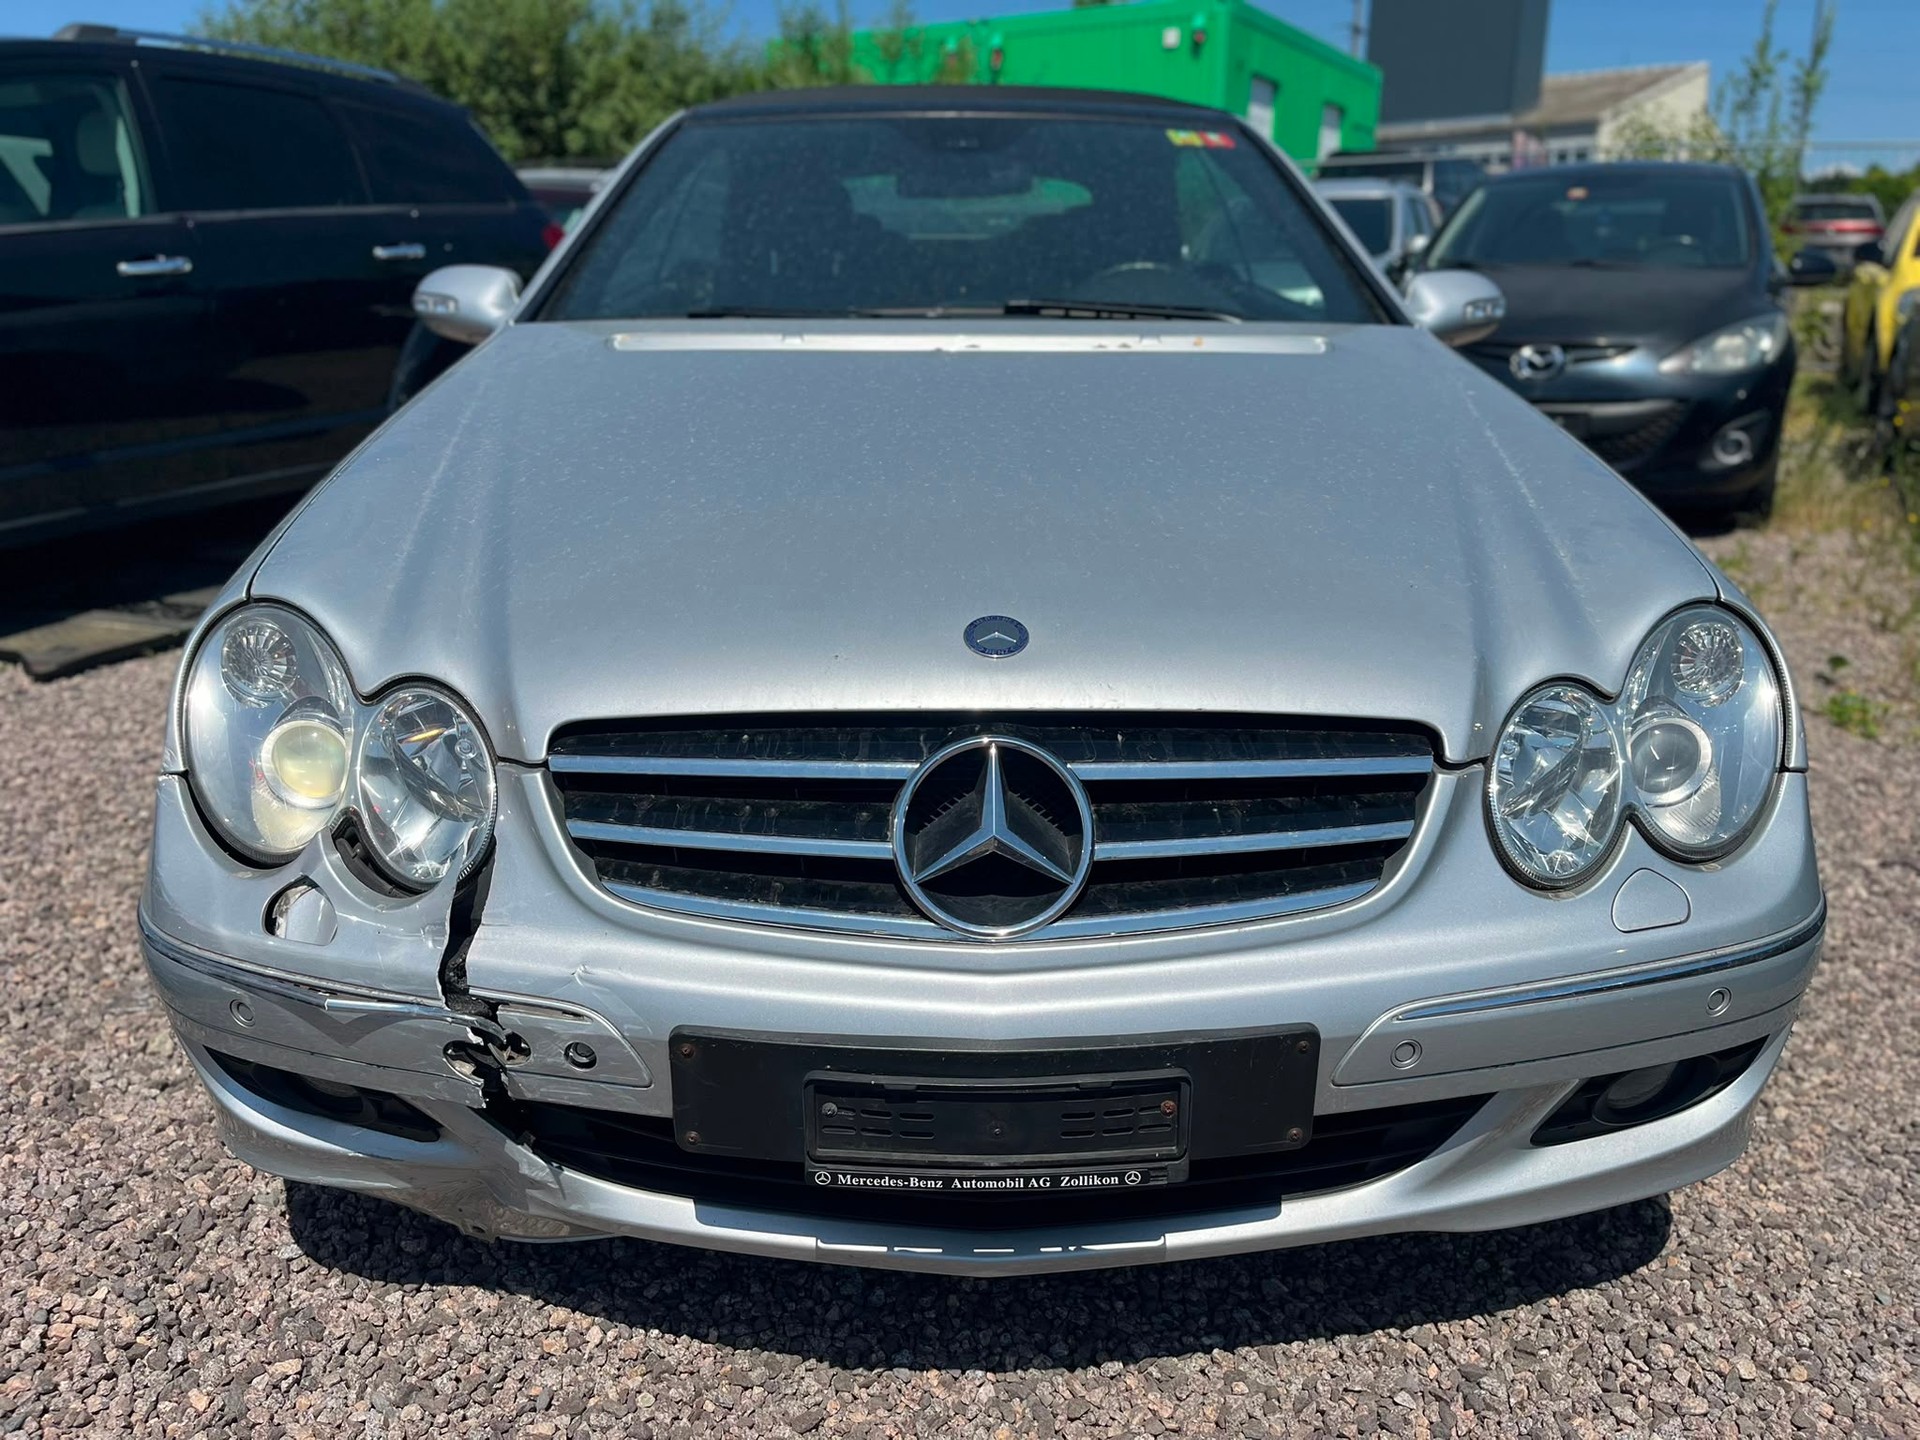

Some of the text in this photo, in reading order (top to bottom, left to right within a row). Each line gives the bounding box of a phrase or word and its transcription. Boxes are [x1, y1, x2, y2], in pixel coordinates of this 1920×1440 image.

[837, 1174, 1119, 1189] Mercedes-Benz Automobil AG Zollikon
